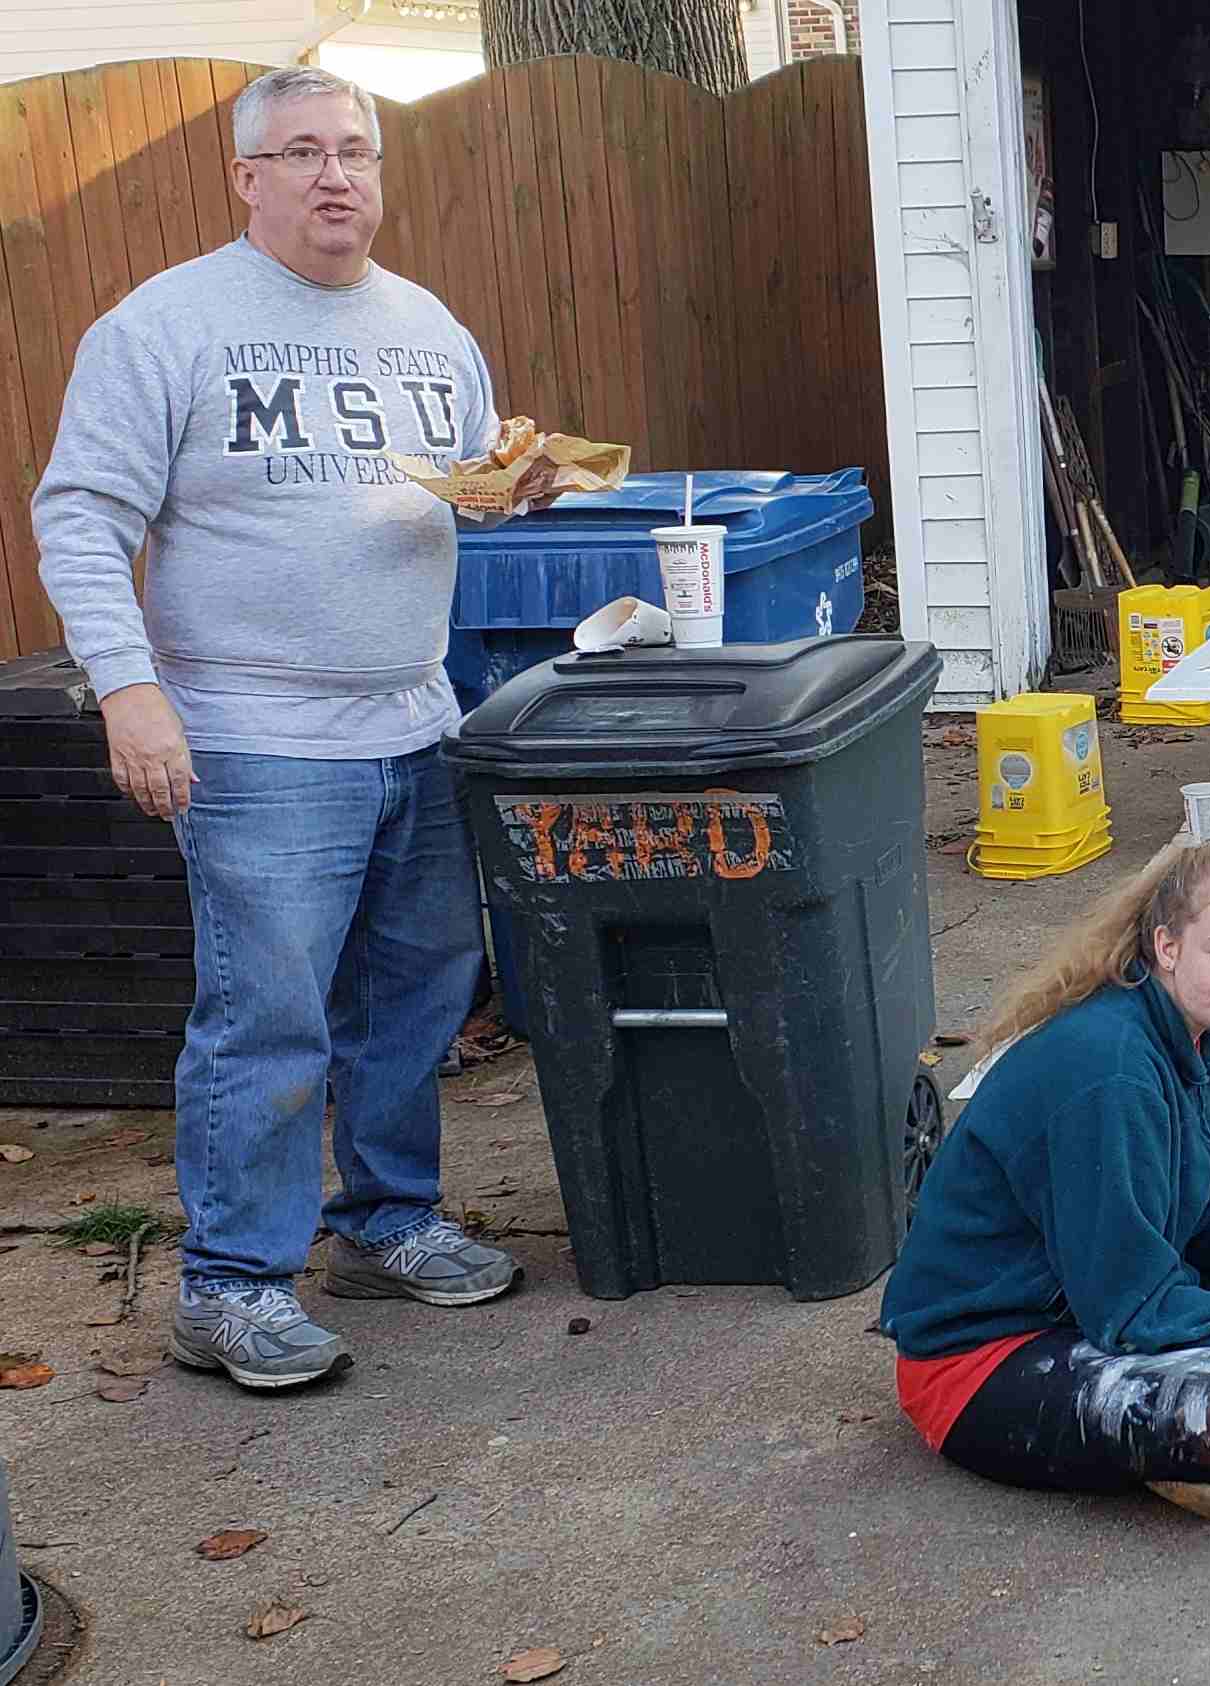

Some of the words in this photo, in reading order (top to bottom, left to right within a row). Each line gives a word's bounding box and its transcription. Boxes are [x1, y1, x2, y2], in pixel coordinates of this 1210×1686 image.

[224, 343, 361, 376] MEMPHIS
[376, 347, 454, 379] STATE
[264, 453, 448, 485] UNIVERSY
